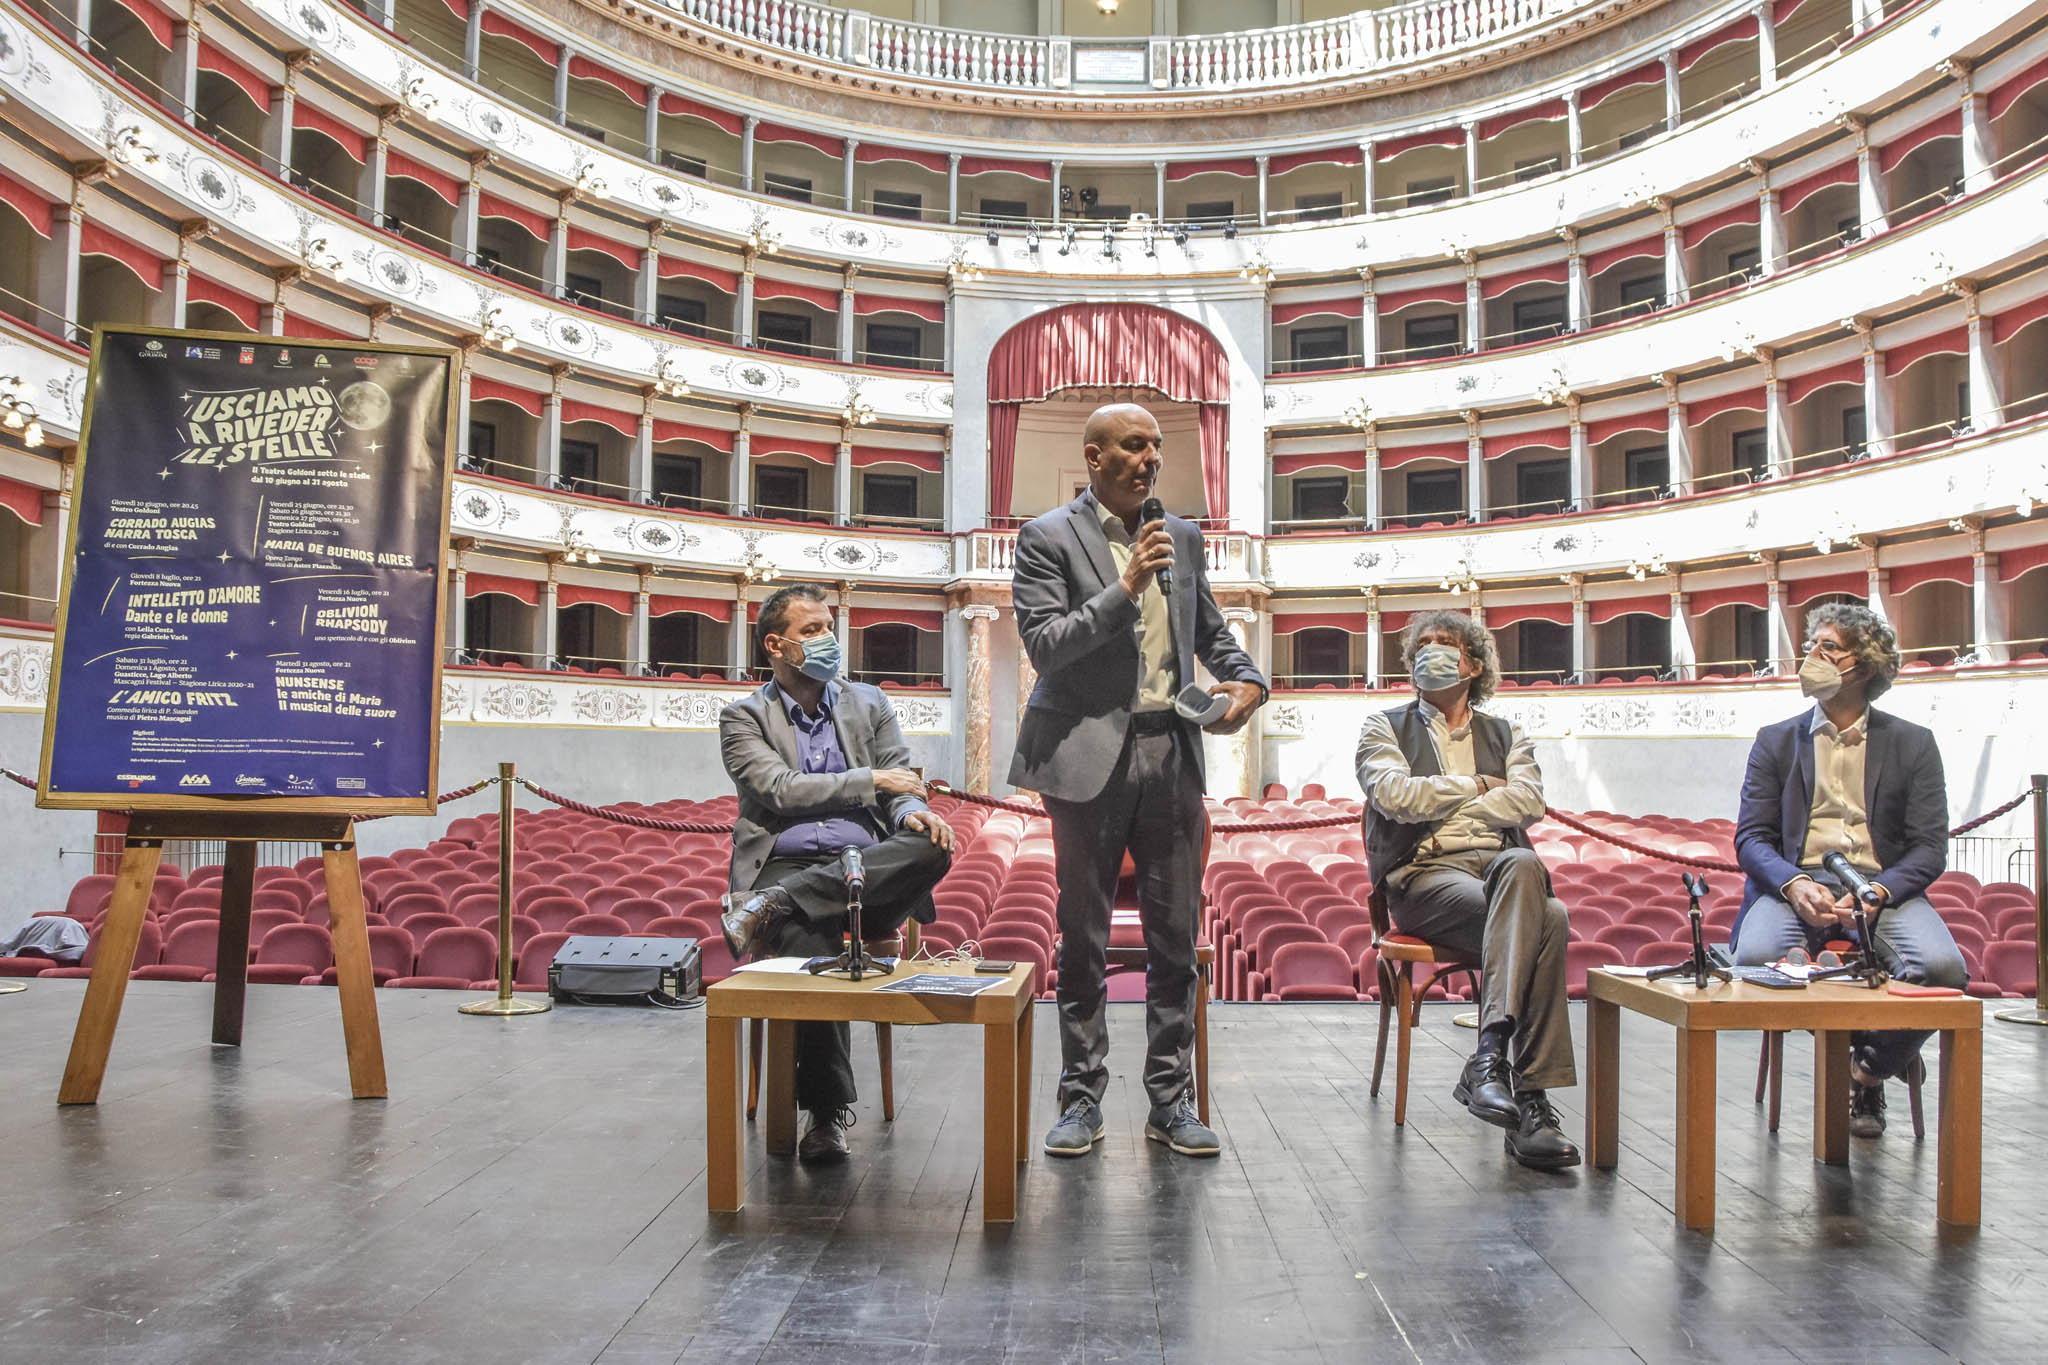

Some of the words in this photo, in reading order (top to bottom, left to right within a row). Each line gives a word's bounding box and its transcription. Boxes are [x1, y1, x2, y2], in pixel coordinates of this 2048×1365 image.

[192, 386, 333, 422] USCIAMO
[188, 422, 212, 444] A
[215, 407, 333, 443] RIVEDER
[181, 446, 223, 464] LE
[226, 431, 332, 463] STELLE
[260, 467, 285, 475] Teatro
[288, 468, 316, 476] Goldoni
[317, 469, 338, 477] sotto
[276, 478, 300, 486] giugno
[110, 518, 167, 528] CORRADO
[171, 517, 216, 528] AUGIAS
[104, 528, 151, 539] NARRA
[155, 529, 198, 540] TOSCA
[264, 540, 304, 551] MARIA
[308, 543, 323, 554] DE
[327, 546, 374, 562] BUENOS
[378, 553, 413, 567] AIRES
[128, 590, 205, 607] INTELLETTO
[208, 585, 261, 604] D'AMORE
[125, 608, 162, 623] Dante
[166, 612, 173, 623] e
[177, 609, 188, 623] le
[192, 608, 228, 624] donne
[317, 603, 378, 618] OBLIVION
[316, 618, 388, 635] RHAPSODY
[275, 677, 345, 690] NUNSENSE
[186, 692, 239, 707] FRITZ
[277, 689, 288, 699] le
[291, 690, 332, 701] amiche
[335, 692, 346, 703] di
[349, 693, 382, 706] Maria
[279, 701, 287, 710] Il
[290, 702, 332, 713] musical
[335, 704, 361, 716] delle
[364, 708, 397, 718] suore
